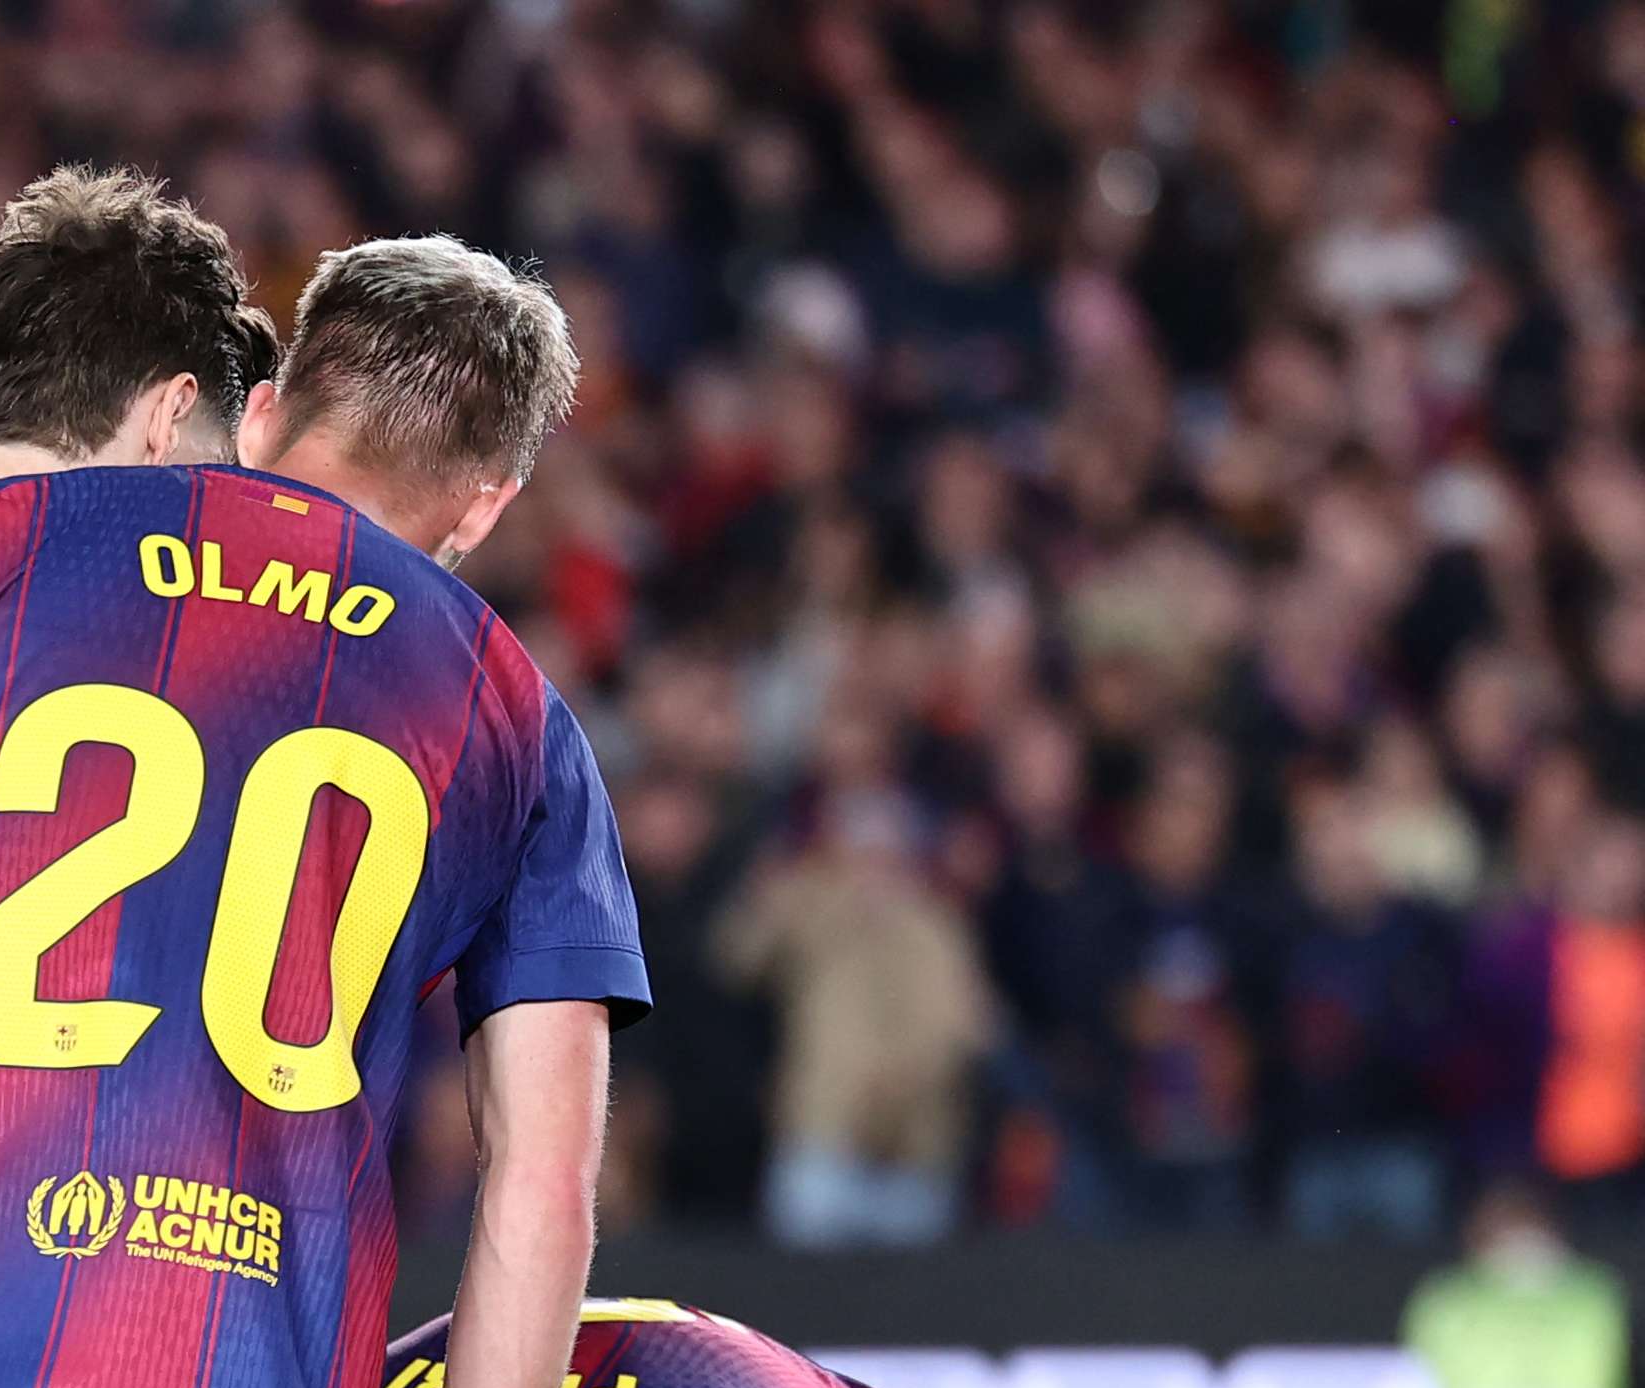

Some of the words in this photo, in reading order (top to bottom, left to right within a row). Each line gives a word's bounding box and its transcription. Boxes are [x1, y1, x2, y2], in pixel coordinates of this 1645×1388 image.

[138, 533, 397, 637] OLMO
[132, 1174, 283, 1241] UNHCR
[125, 1209, 280, 1273] ACNUR
[125, 1243, 152, 1259] The
[152, 1248, 175, 1263] UN
[175, 1252, 232, 1273] Refugee
[232, 1261, 279, 1288] Agency
